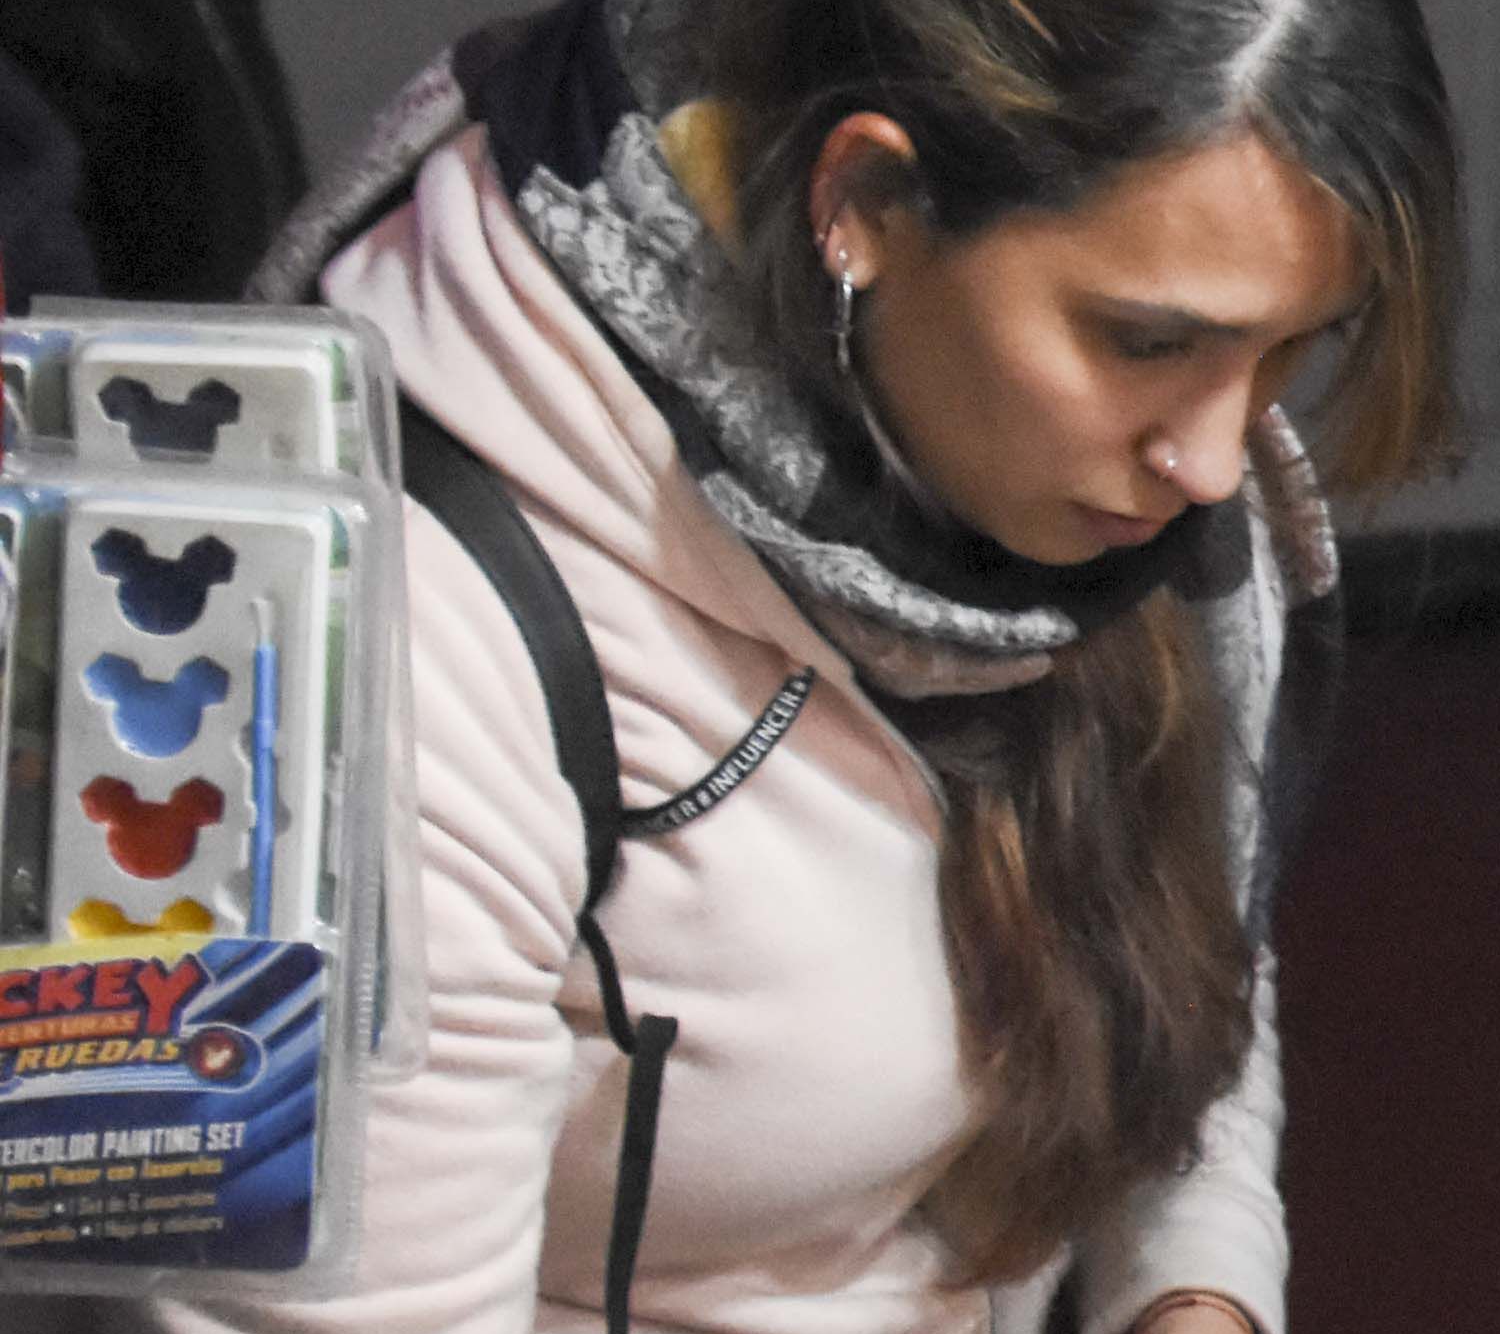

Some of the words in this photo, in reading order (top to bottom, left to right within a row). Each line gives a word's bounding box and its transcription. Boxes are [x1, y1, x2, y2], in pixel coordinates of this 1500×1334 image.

[14, 1038, 182, 1073] RUEDAS
[102, 1124, 201, 1157] PAINTING
[206, 1121, 247, 1151] SET
